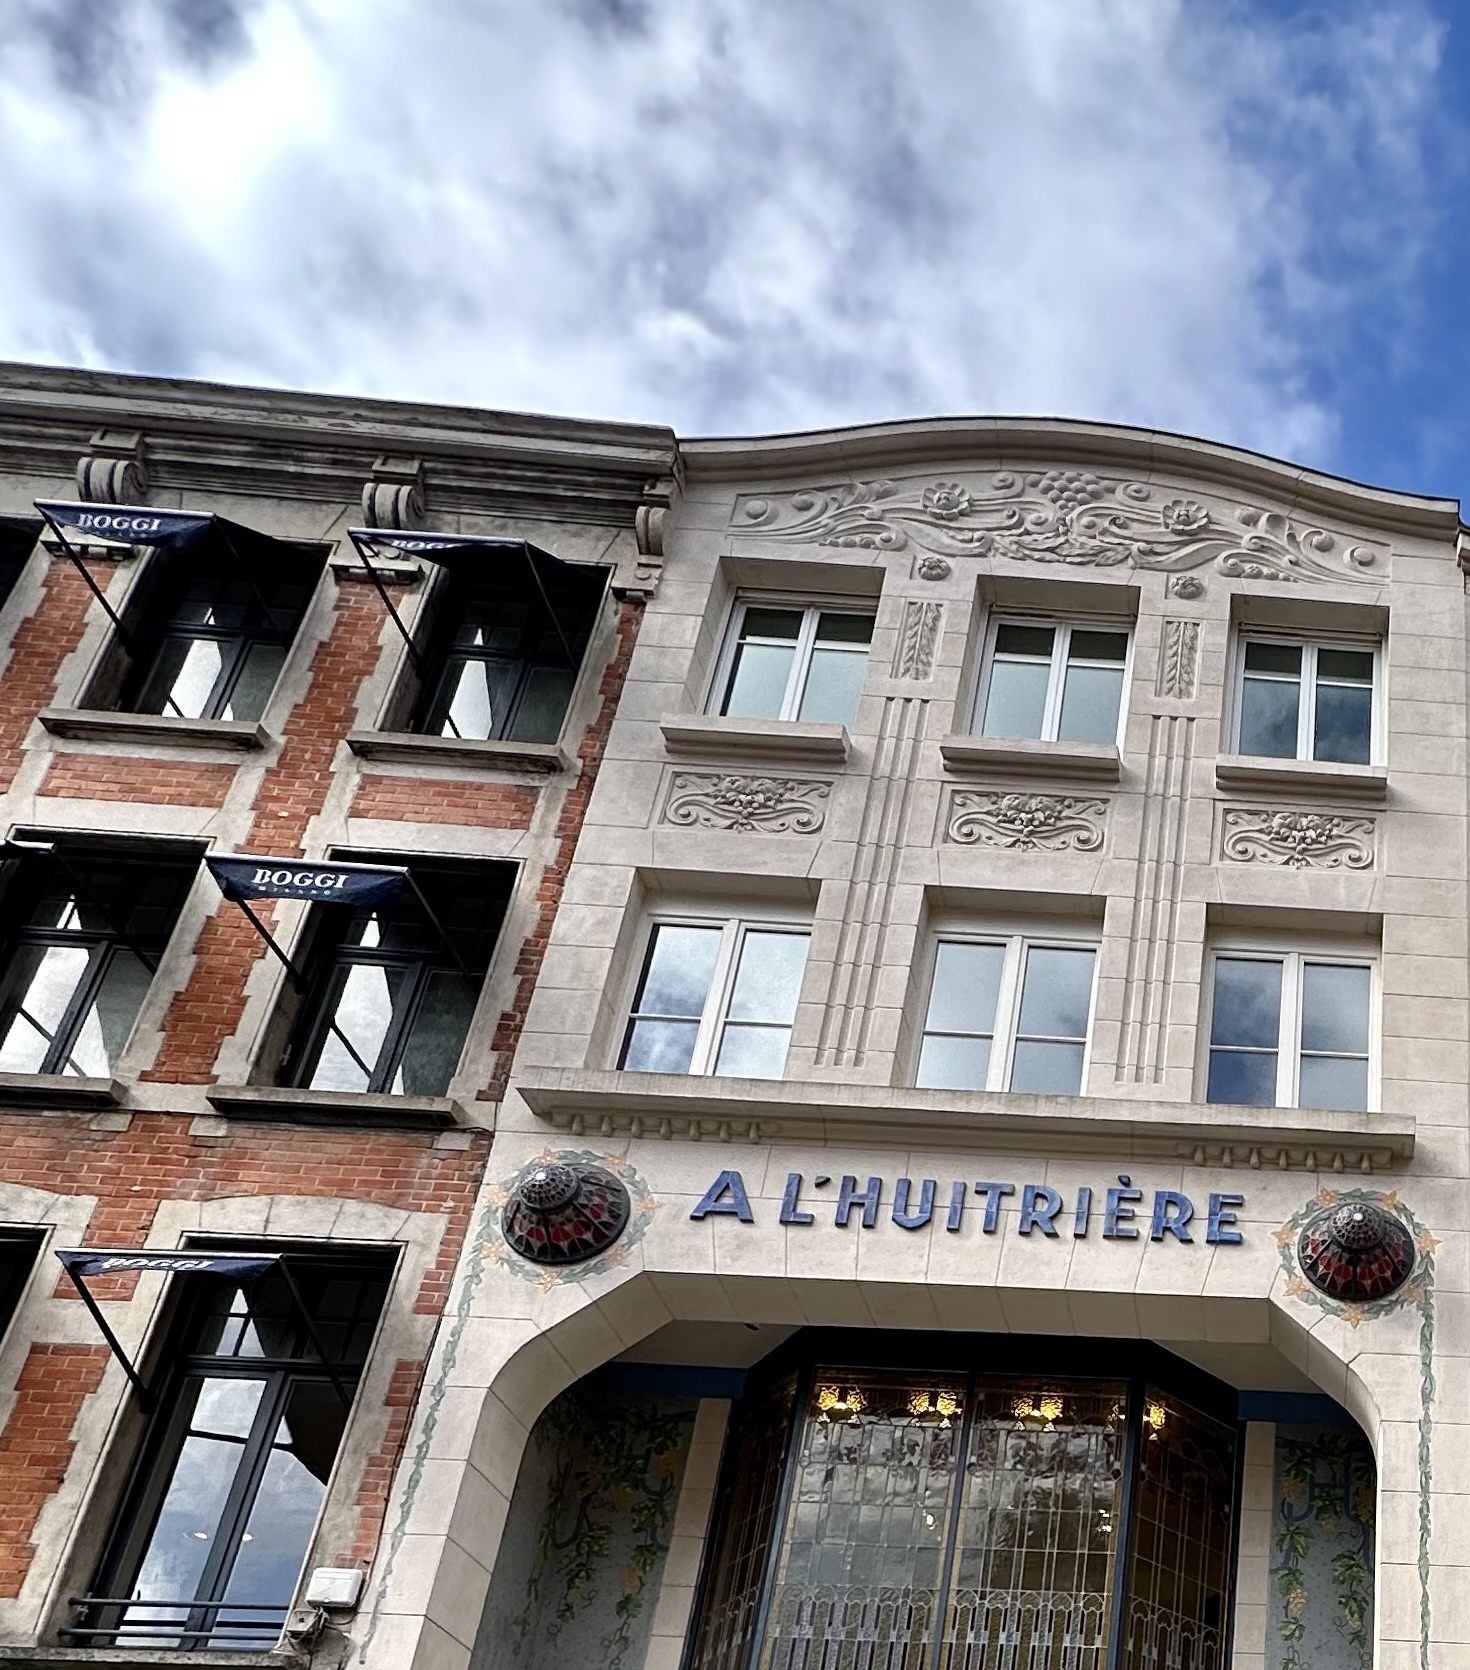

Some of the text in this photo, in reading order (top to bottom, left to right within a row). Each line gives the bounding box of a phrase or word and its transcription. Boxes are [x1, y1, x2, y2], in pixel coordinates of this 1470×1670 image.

[78, 513, 162, 531] BOGGI
[252, 869, 348, 889] BOGGI
[690, 1170, 1245, 1245] A L'HUITRIÈRE
